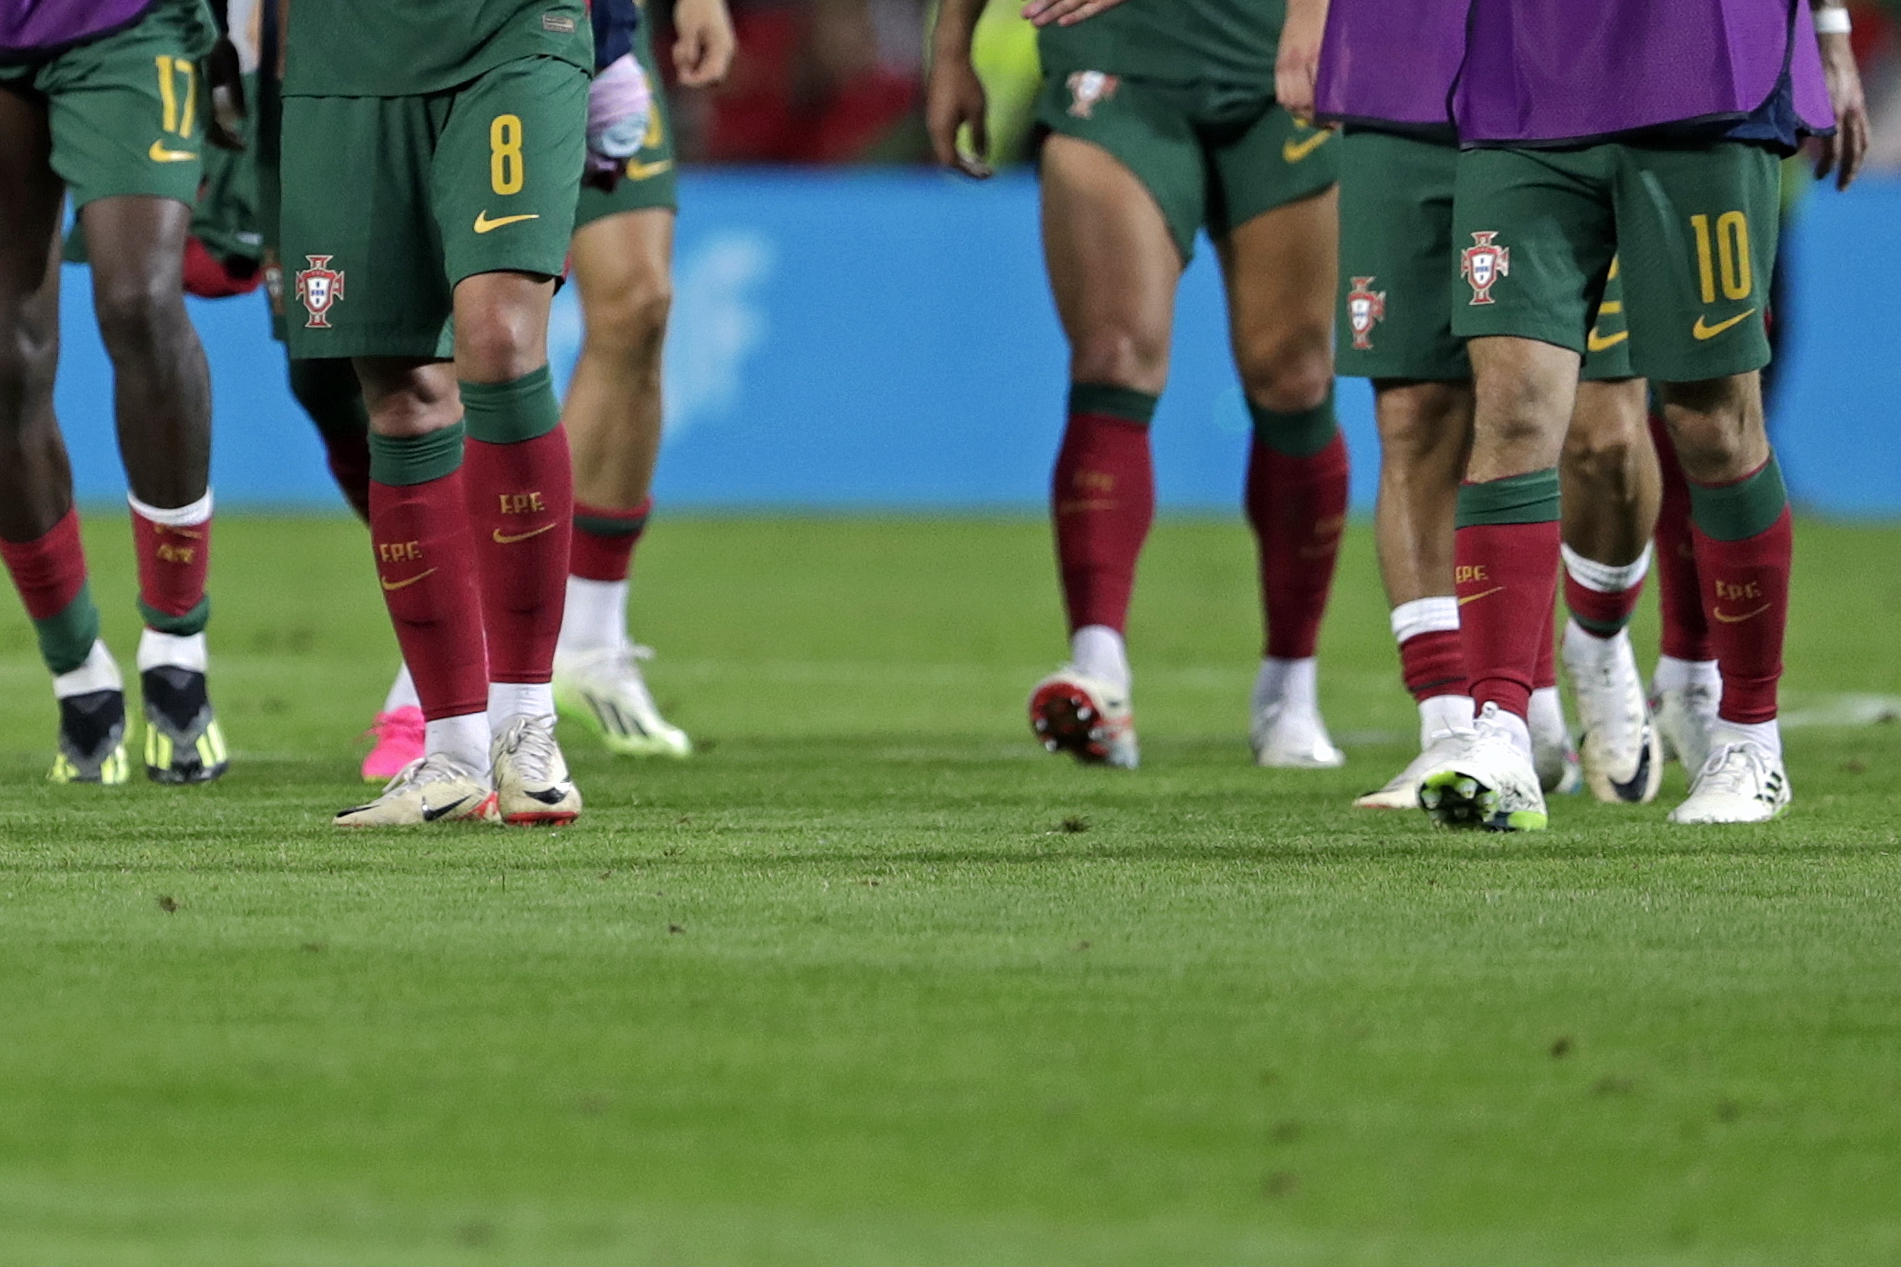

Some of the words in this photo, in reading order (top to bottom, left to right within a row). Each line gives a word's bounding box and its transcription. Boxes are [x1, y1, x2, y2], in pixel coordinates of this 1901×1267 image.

[155, 55, 196, 140] 17
[490, 114, 524, 196] 8
[1690, 210, 1752, 304] 10
